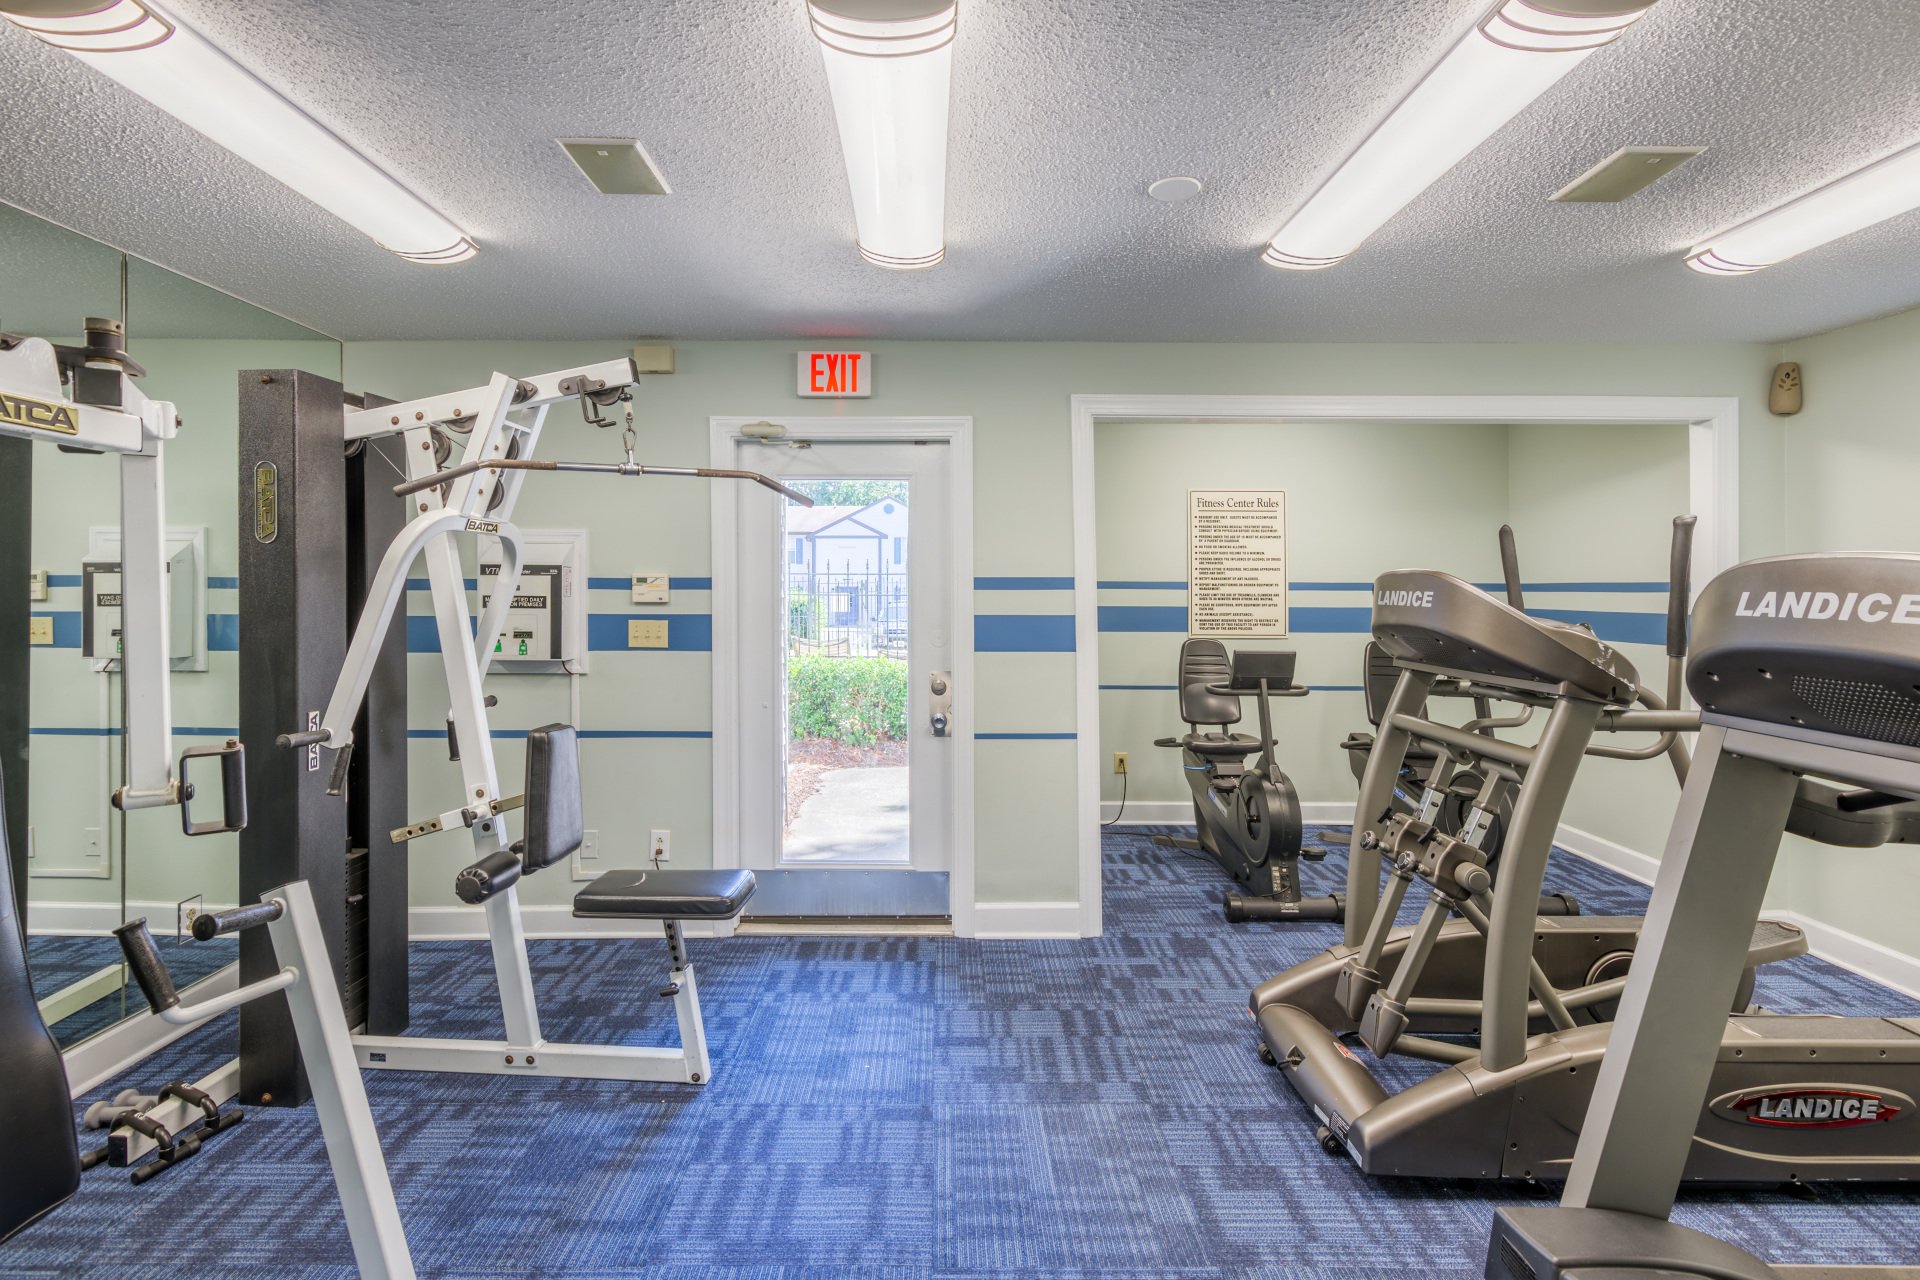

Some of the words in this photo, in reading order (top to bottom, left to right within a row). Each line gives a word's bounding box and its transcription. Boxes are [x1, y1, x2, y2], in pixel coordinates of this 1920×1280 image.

[811, 354, 861, 392] EXIT
[0, 395, 76, 431] TCA
[1197, 498, 1224, 507] Fitness
[1227, 498, 1254, 507] Center
[1257, 498, 1279, 507] Rules
[468, 521, 498, 533] BATCA
[1377, 590, 1434, 608] LANDICE
[1735, 591, 1920, 625] LANDICE
[310, 712, 319, 770] BAA
[1760, 1098, 1879, 1120] LANDICE
